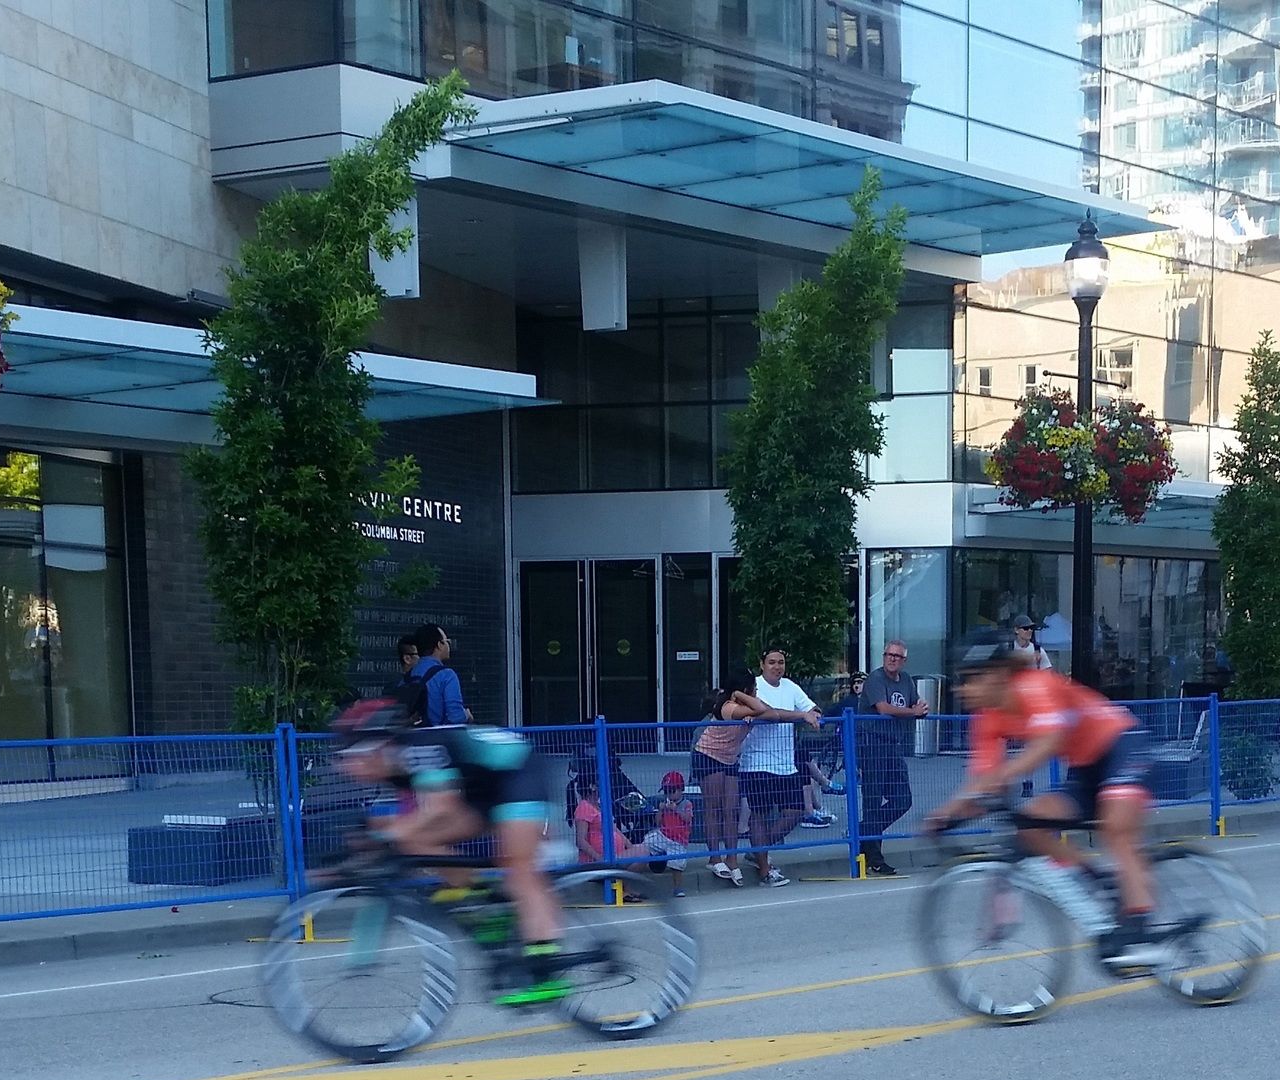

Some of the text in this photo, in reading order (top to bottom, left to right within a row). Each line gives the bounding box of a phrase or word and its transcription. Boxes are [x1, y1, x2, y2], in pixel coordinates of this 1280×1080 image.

[403, 496, 462, 523] CENTRE
[361, 523, 398, 541] COLUMBIA
[399, 528, 425, 544] STREET
